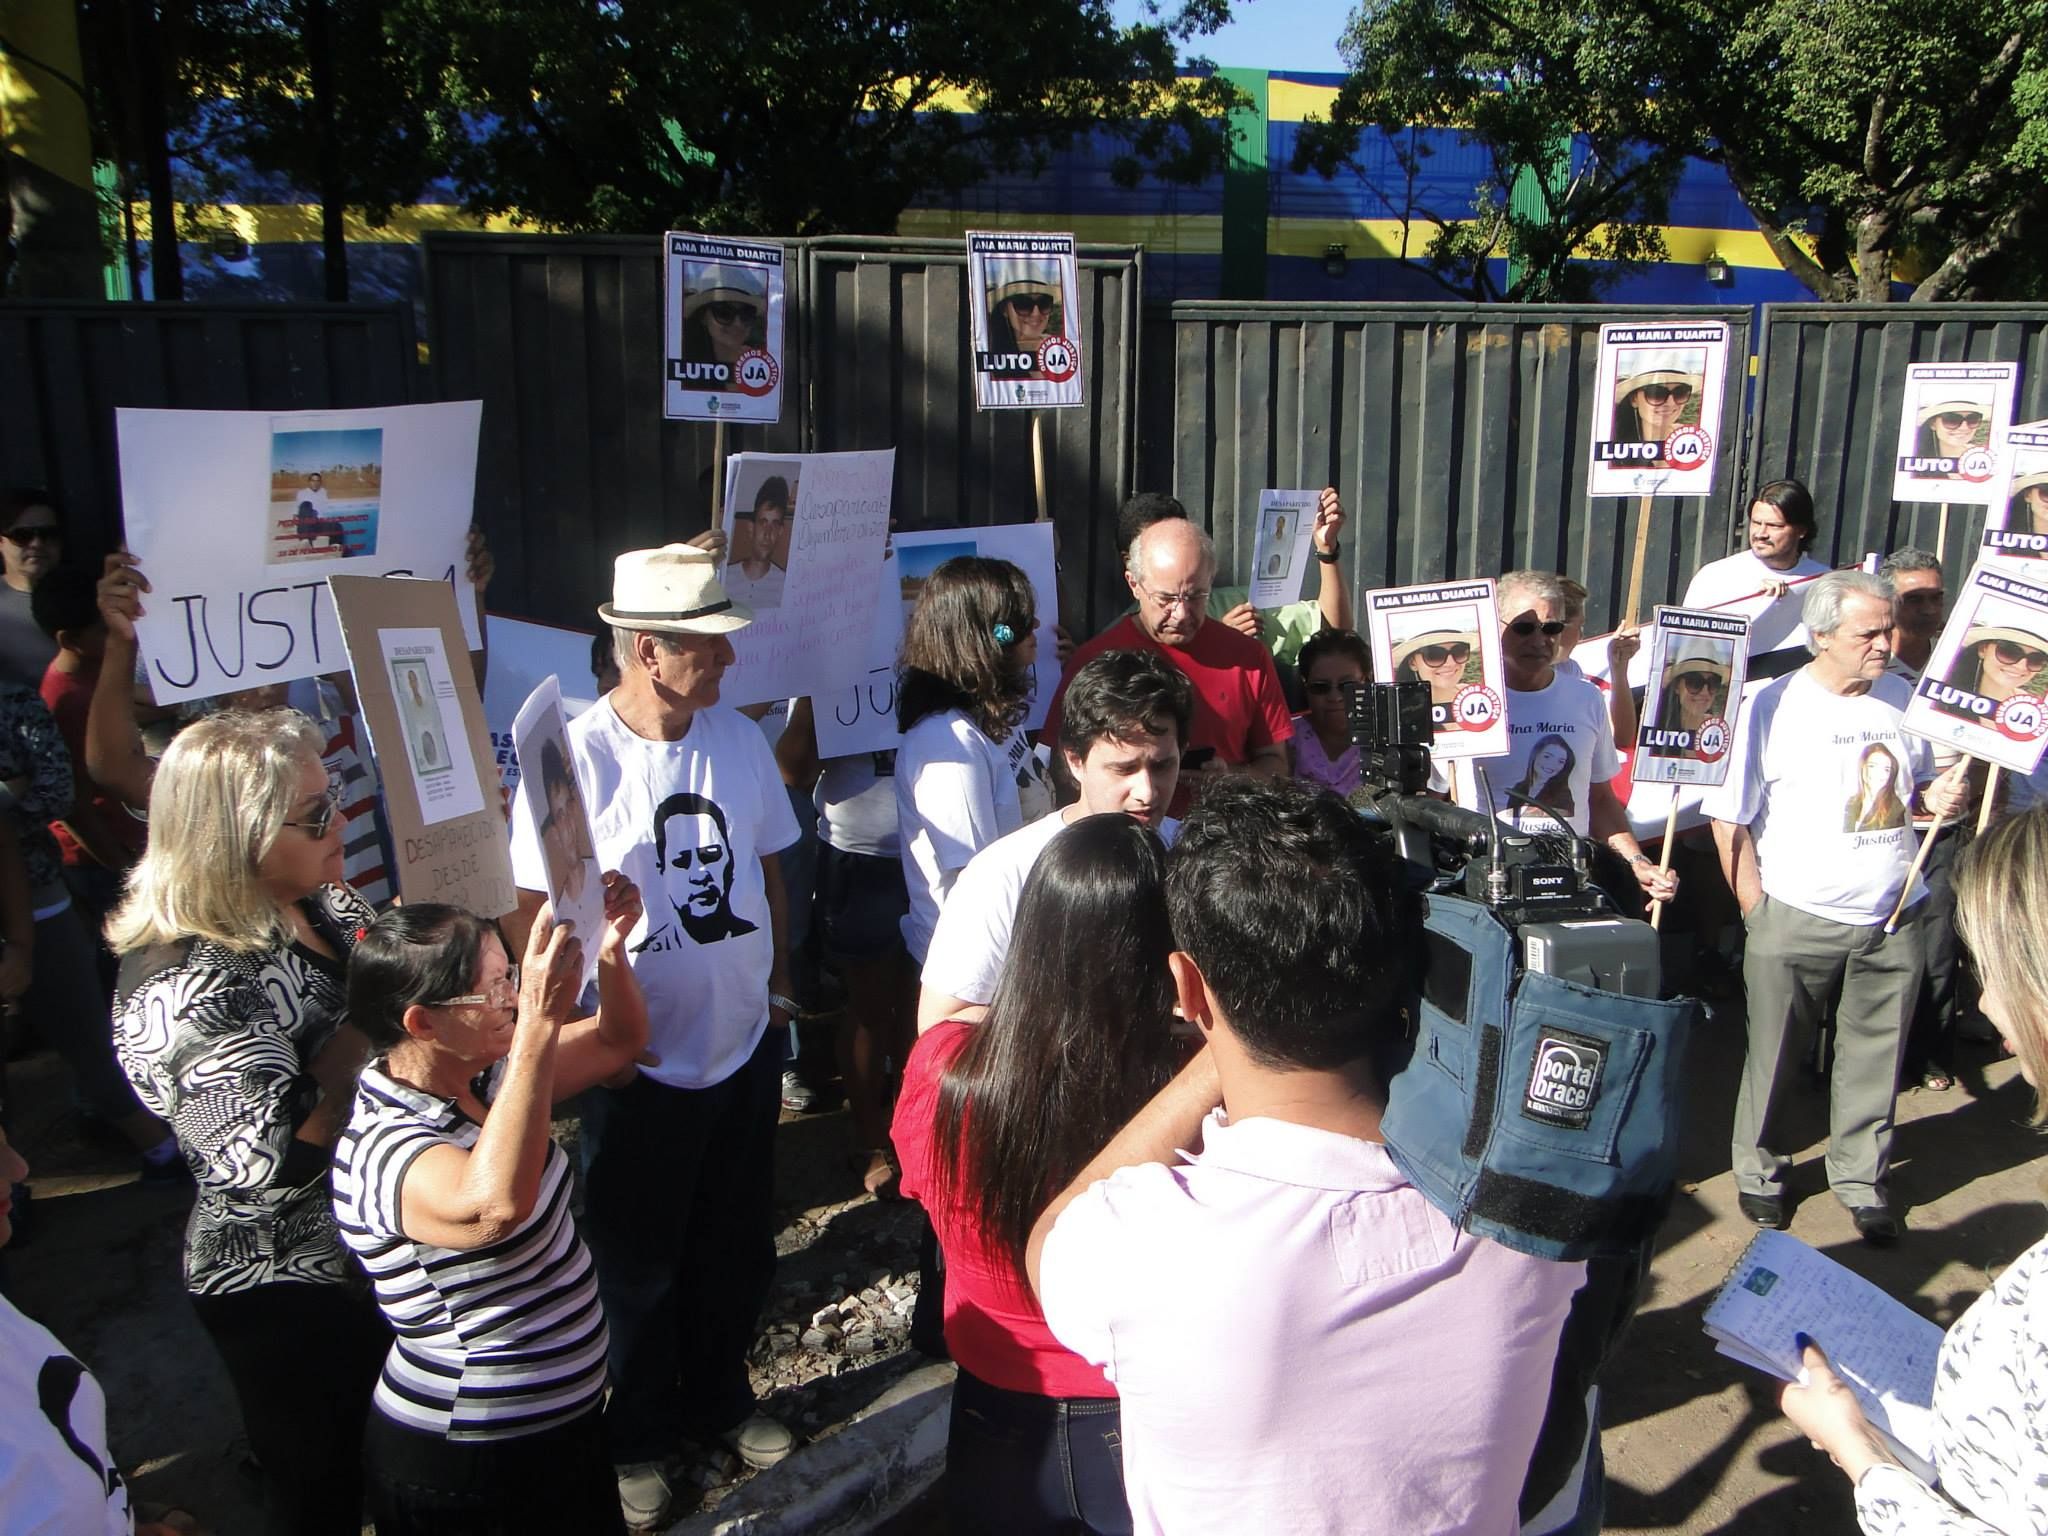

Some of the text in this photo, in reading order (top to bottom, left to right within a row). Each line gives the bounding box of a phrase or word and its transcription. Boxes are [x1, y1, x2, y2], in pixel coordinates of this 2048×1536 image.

[674, 242, 779, 262] ANA MARIA DUARTE
[974, 241, 1070, 251] ANA MARIA DUARTE
[1609, 330, 1722, 342] ANA MARIA DUARTE
[983, 353, 1033, 370] LUTO
[674, 362, 729, 381] LUTO
[1601, 442, 1658, 460] LUTO
[1904, 458, 1954, 472] LUTO
[1990, 531, 2047, 550] LUTO
[1978, 574, 2006, 590] ANA
[1376, 587, 1488, 607] ANA MARIA DUARTE
[155, 564, 456, 689] JUST
[1662, 615, 1745, 632] ANA MARIA DUARTE
[1926, 681, 1992, 714] LUTO
[1536, 722, 1576, 734] Maria
[1860, 730, 1896, 742] Maria
[1645, 729, 1690, 747] LUTO
[1533, 877, 1563, 885] SONY
[1539, 1047, 1592, 1087] porta
[1534, 1074, 1586, 1107] brace
